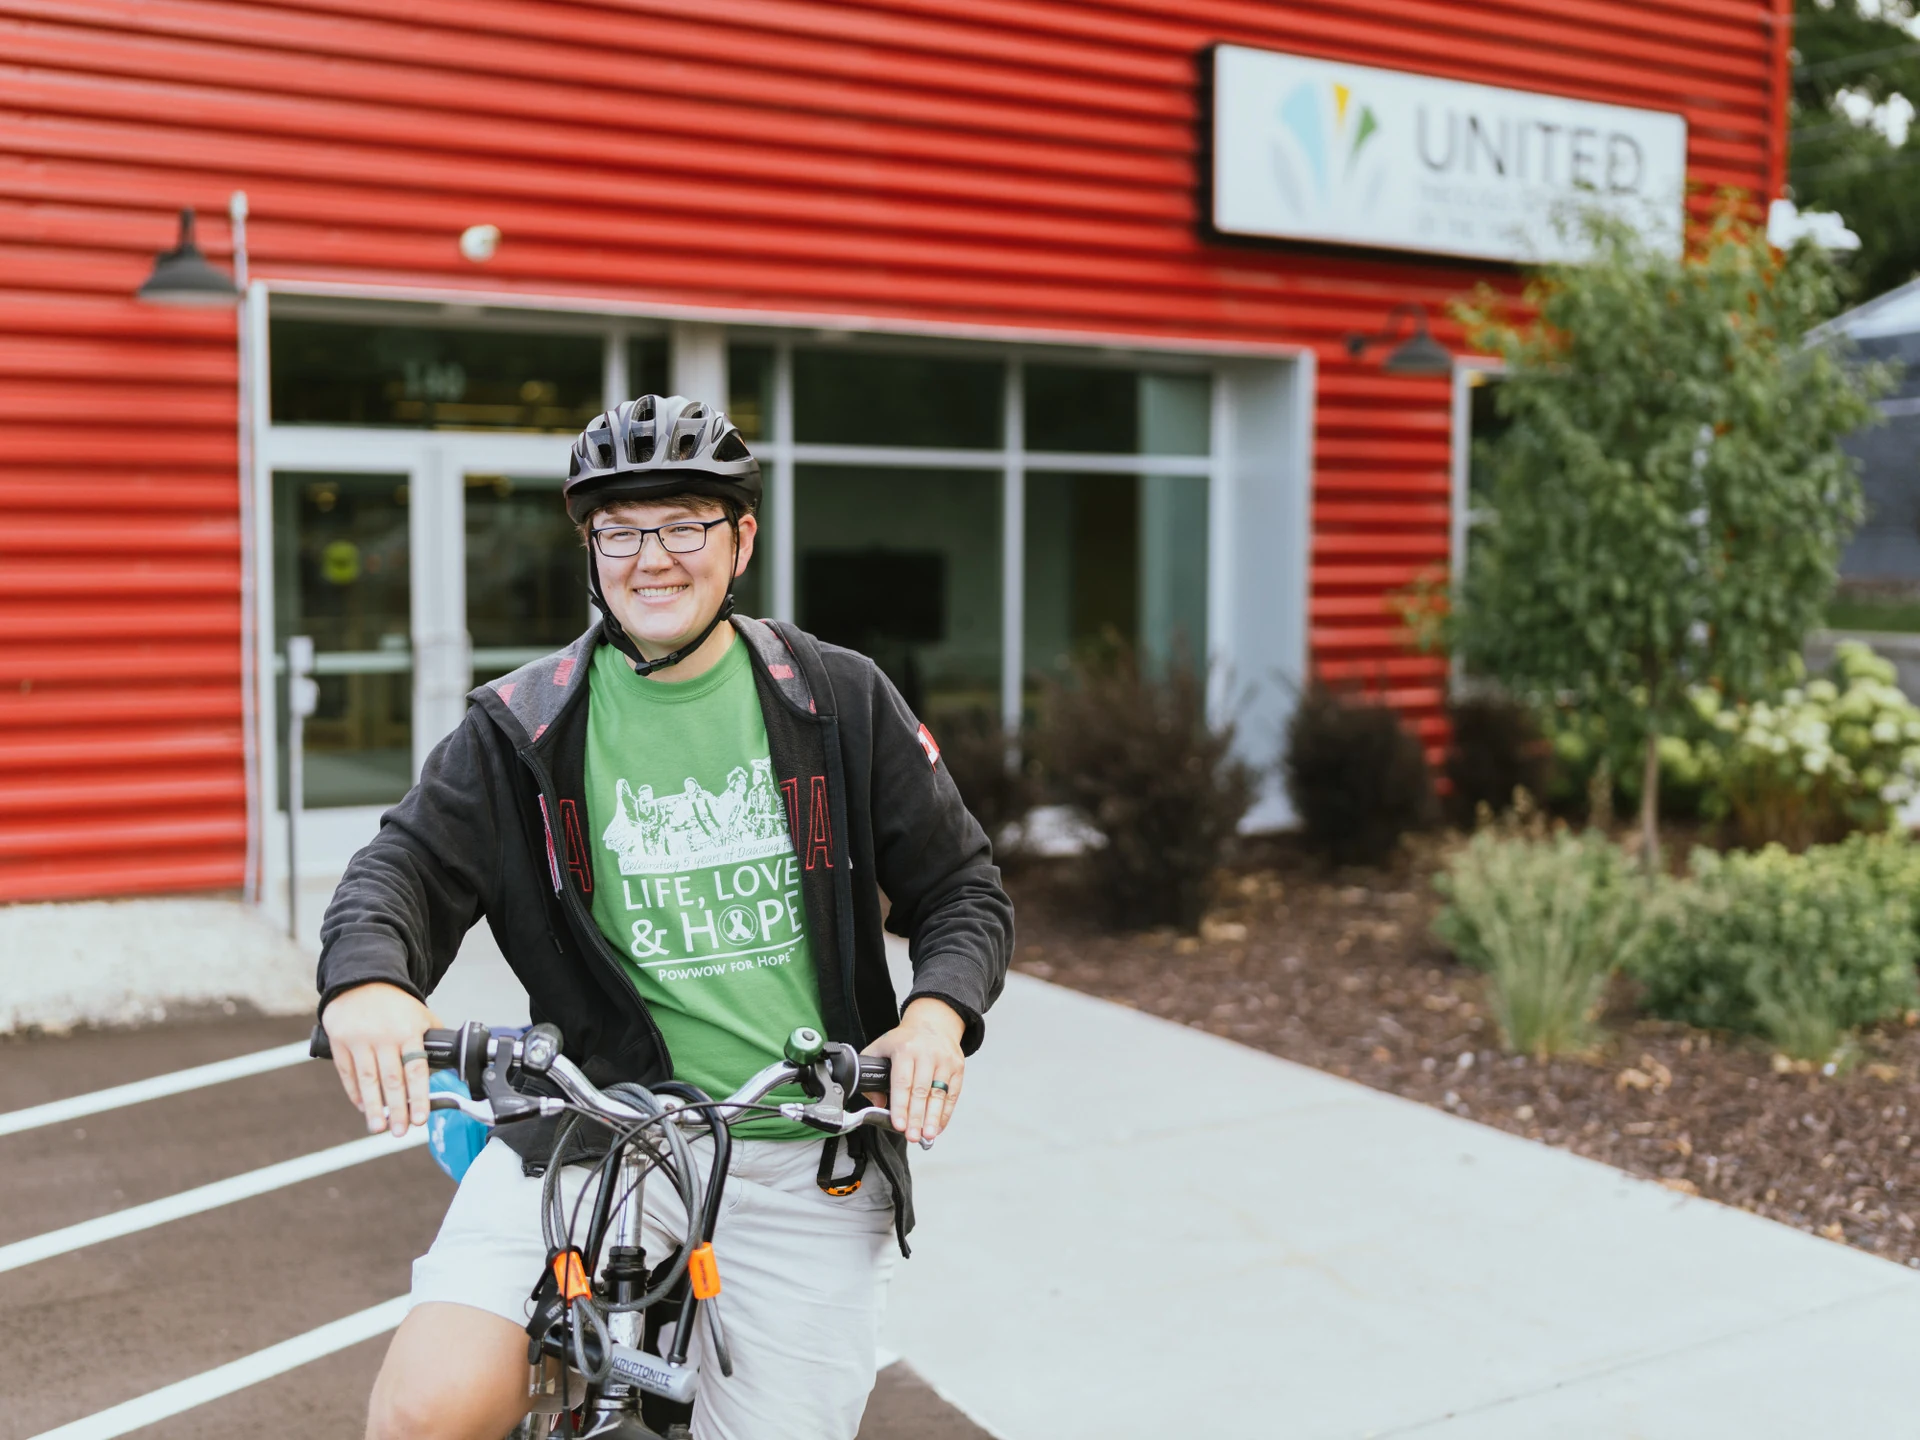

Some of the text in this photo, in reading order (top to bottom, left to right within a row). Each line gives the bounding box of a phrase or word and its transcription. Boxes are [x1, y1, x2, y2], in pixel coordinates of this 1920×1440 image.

[1416, 103, 1644, 196] UNITED
[622, 856, 799, 911] LIFE, LOVE
[683, 858, 690, 868] 5
[694, 853, 720, 870] years
[724, 851, 734, 864] of
[738, 842, 780, 858] Dancing
[631, 890, 802, 958] & HOPE
[612, 1356, 671, 1388] KRYPTONITE
